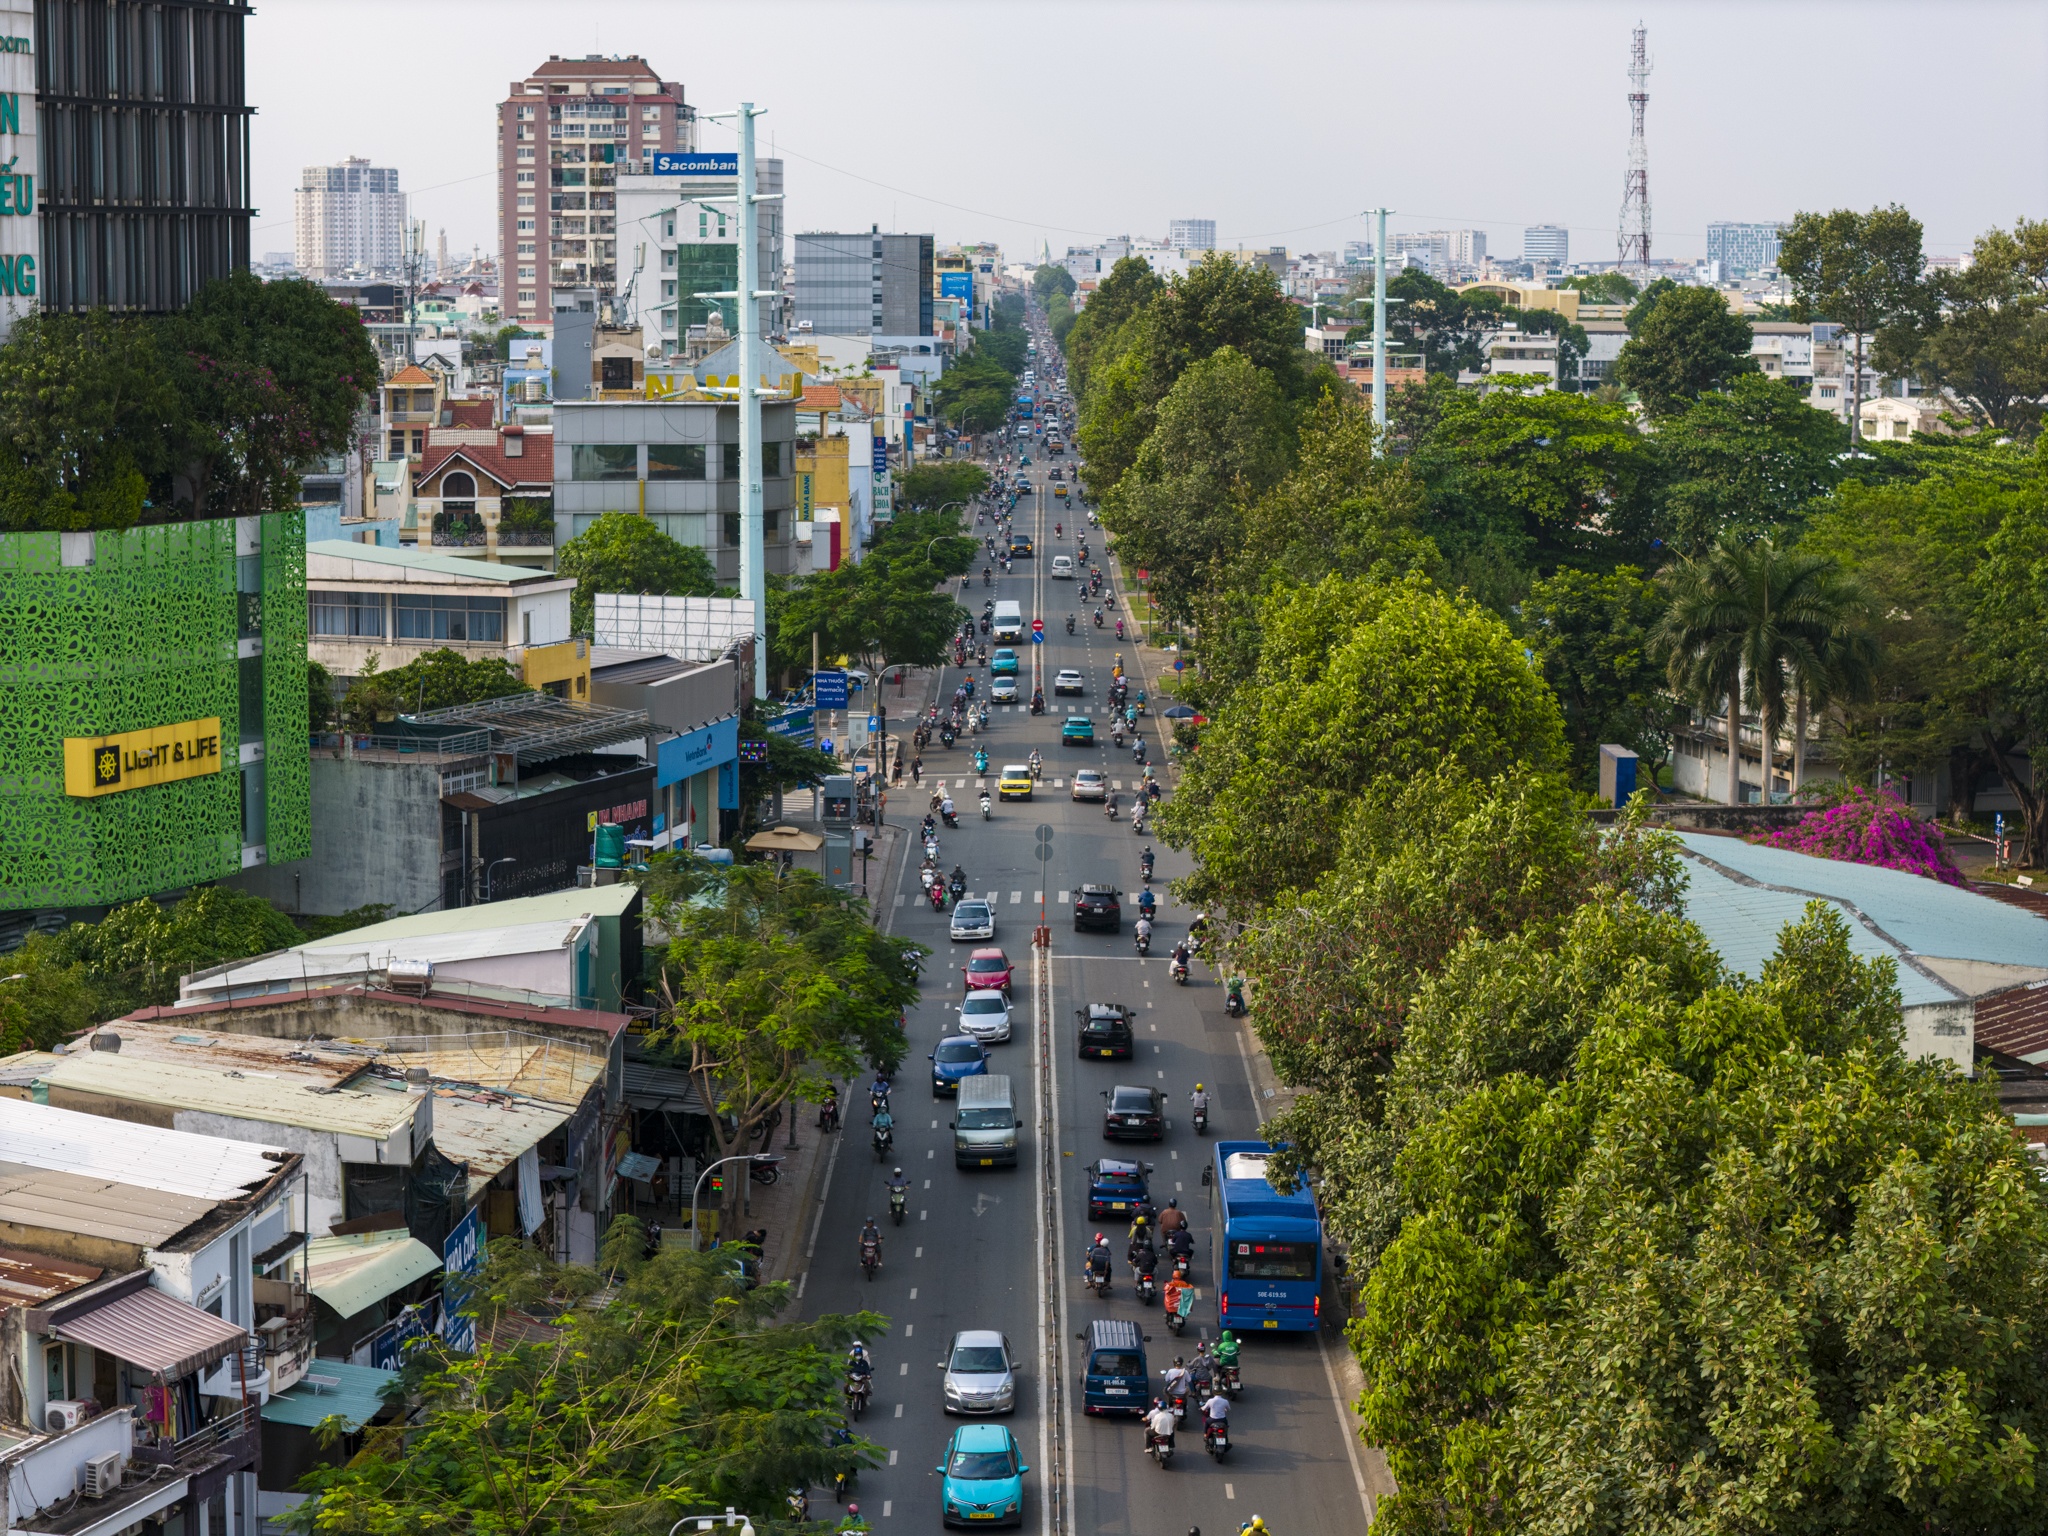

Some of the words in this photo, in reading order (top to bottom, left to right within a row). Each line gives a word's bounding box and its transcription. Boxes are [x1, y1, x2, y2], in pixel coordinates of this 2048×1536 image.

[658, 156, 739, 171] Sacomban
[803, 474, 811, 495] BANK
[124, 744, 170, 772] LIGHT
[172, 741, 185, 763] &
[187, 735, 217, 761] LIFE
[1239, 1245, 1248, 1253] 08
